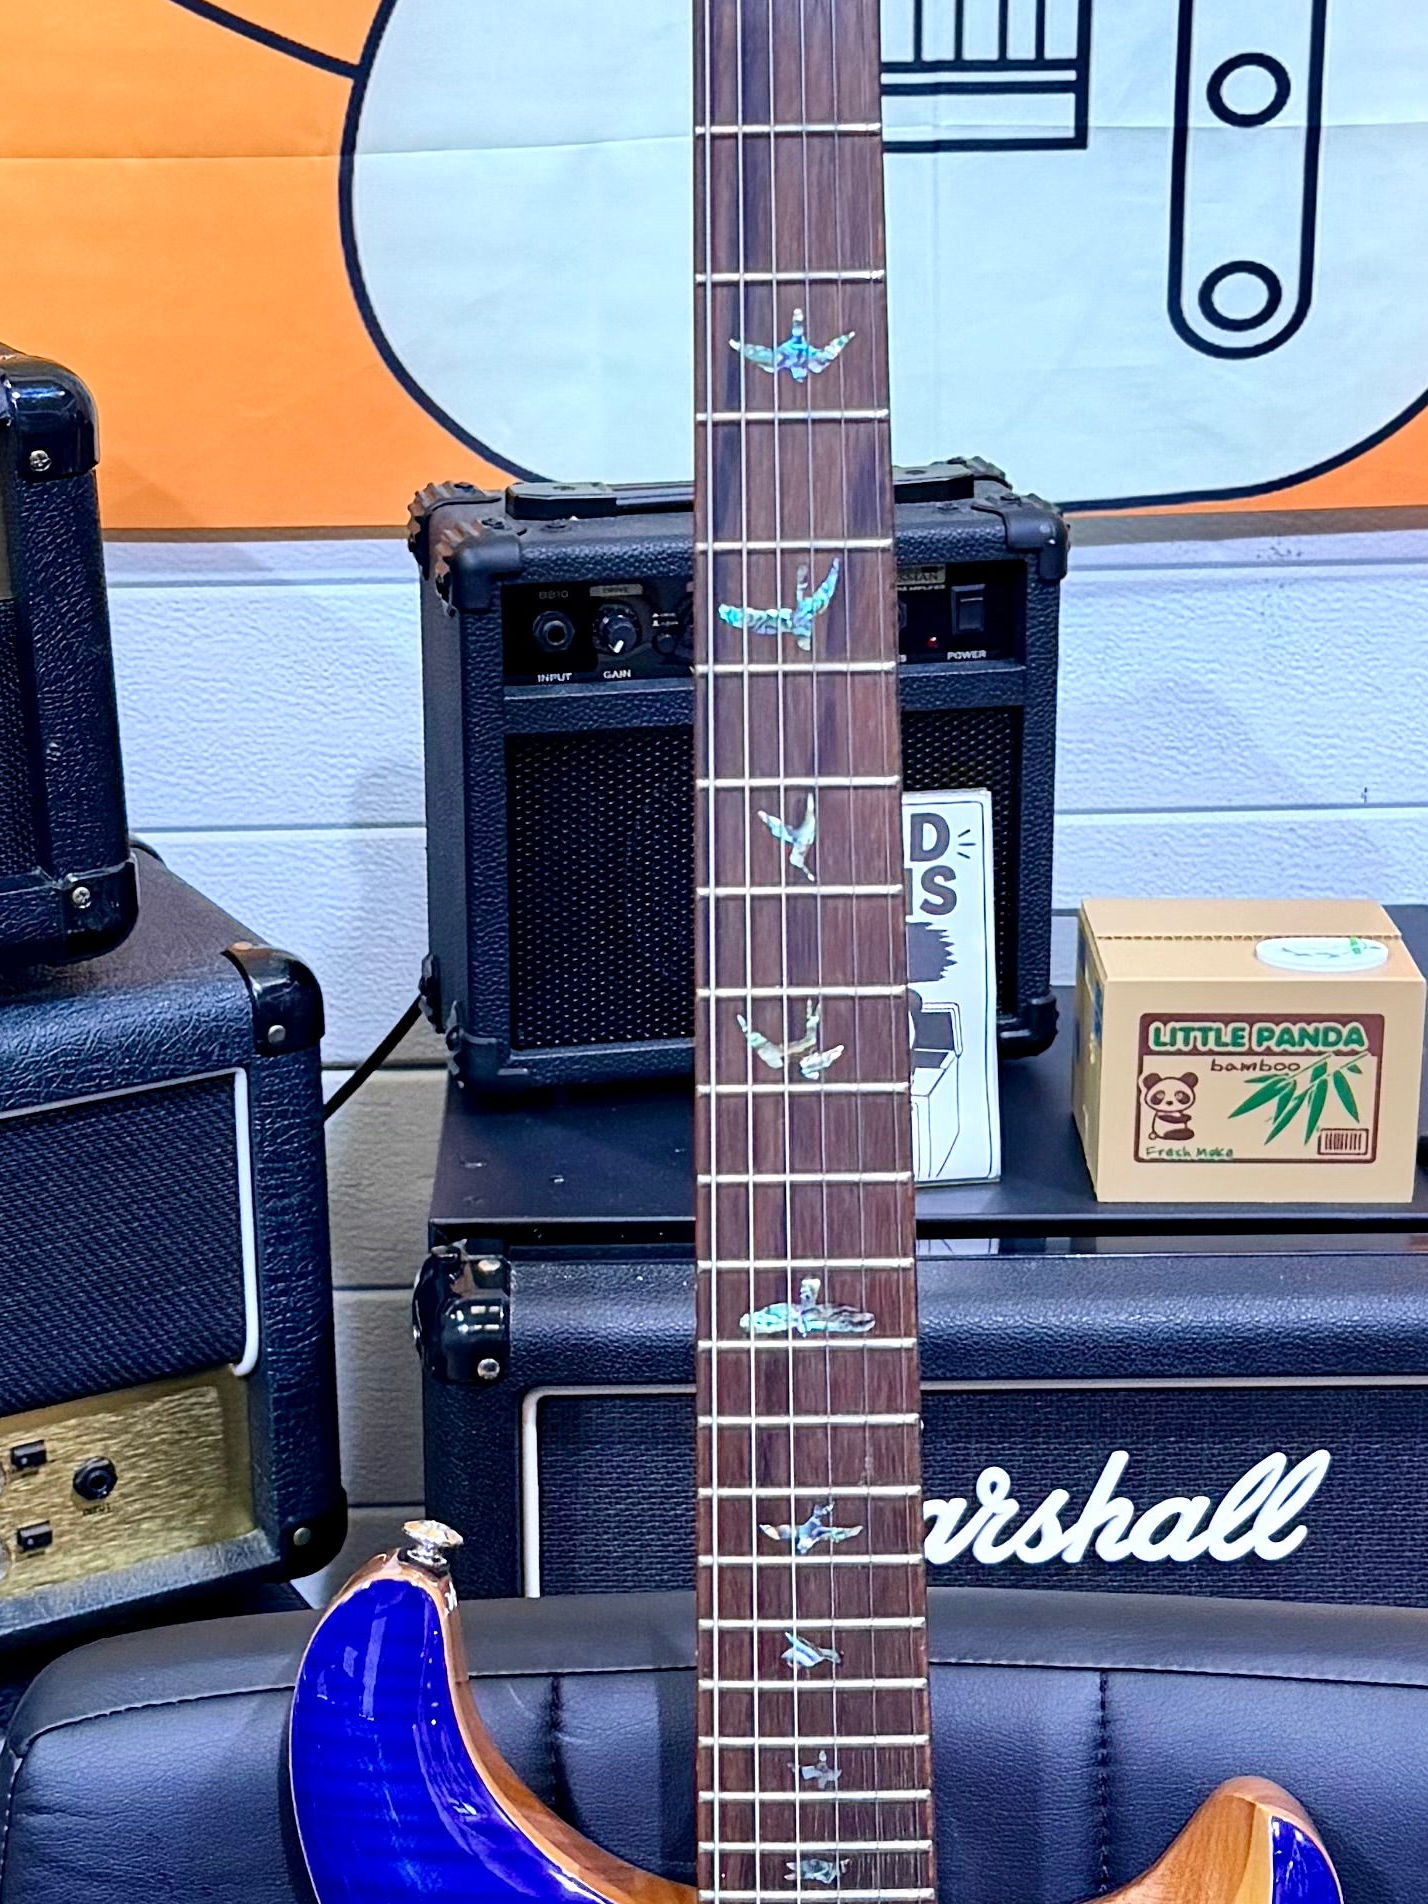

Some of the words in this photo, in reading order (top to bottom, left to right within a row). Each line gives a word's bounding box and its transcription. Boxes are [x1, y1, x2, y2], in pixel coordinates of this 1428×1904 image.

[947, 649, 987, 661] POWER
[537, 672, 573, 683] INPUT
[603, 669, 632, 680] GAIN
[1150, 1022, 1249, 1050] LITTLE
[1254, 1022, 1369, 1051] PANDA
[1210, 1057, 1301, 1073] bamboo
[1145, 1145, 1192, 1158] Fresh
[923, 1449, 1331, 1565] arshall
